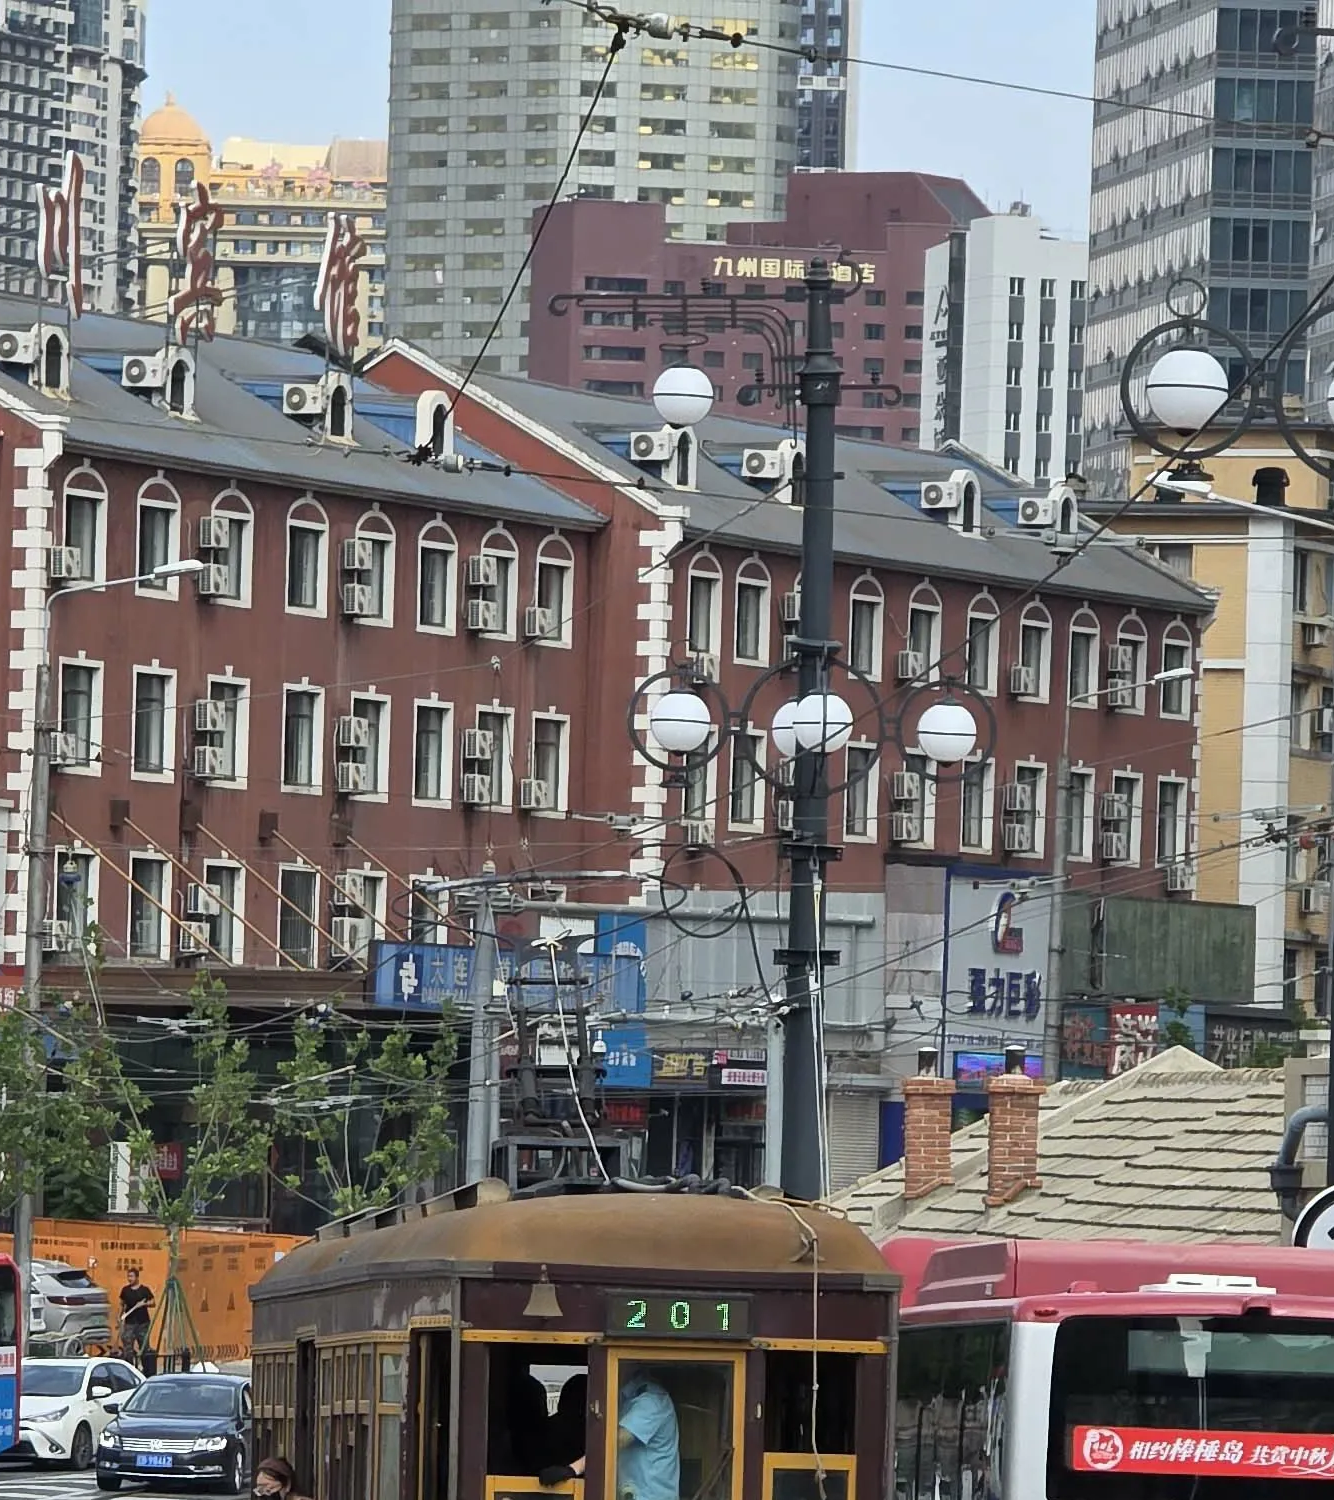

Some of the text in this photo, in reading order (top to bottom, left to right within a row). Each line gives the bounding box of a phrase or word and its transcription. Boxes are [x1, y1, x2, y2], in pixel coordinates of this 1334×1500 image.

[713, 256, 876, 284] 九州国际酒店
[626, 1300, 729, 1331] 201
